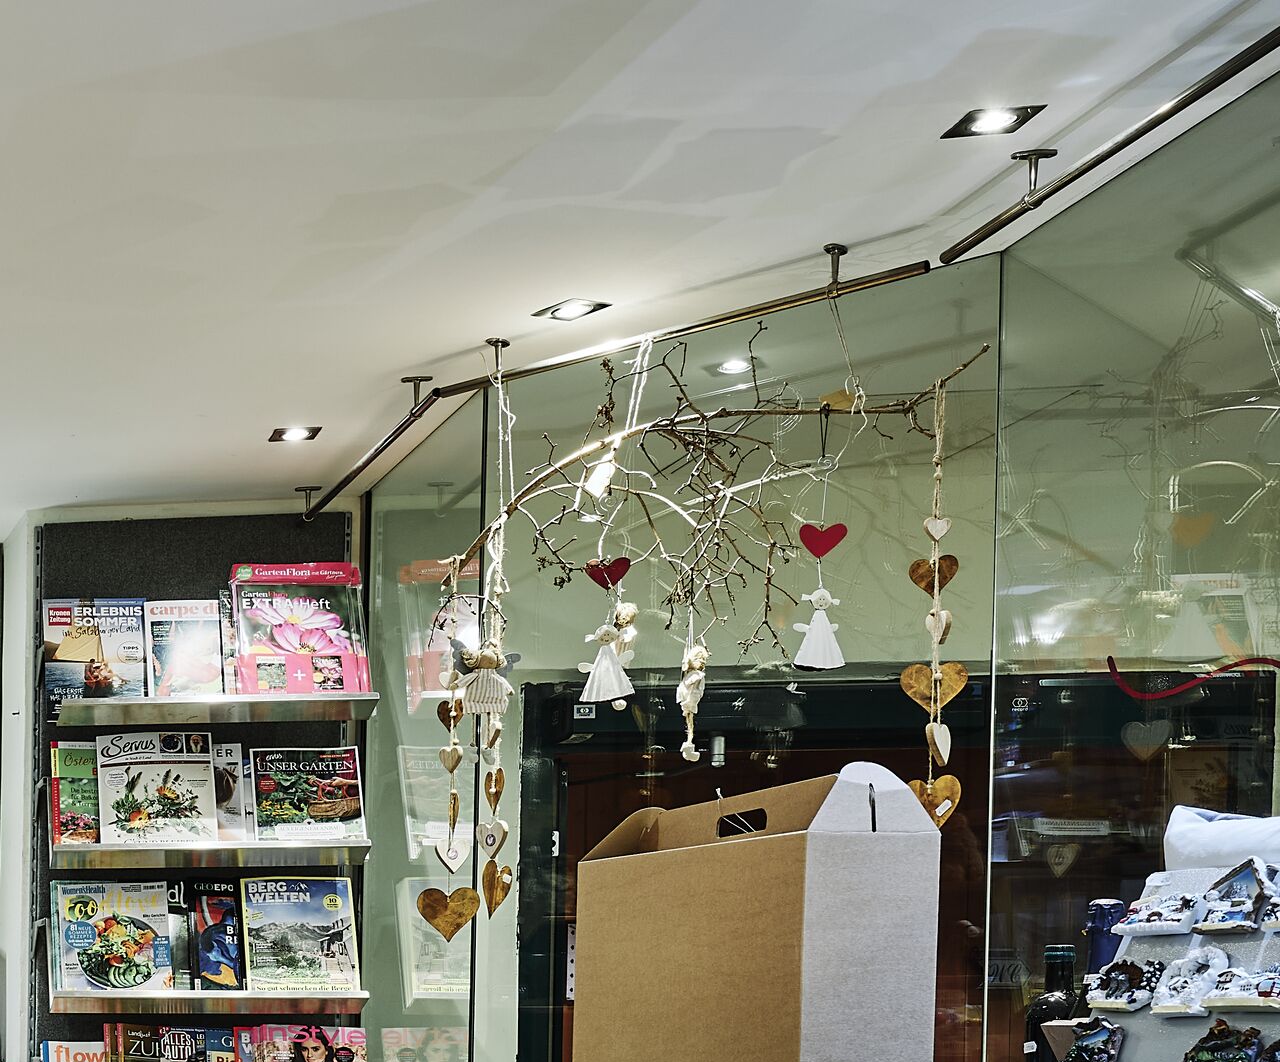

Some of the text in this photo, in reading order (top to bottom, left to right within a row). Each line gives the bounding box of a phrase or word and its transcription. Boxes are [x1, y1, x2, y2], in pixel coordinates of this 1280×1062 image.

[255, 568, 310, 577] GartenFlora
[242, 598, 331, 610] EXTRA-Heft
[74, 606, 143, 617] ERLEBNIS
[150, 605, 198, 618] carpe
[49, 616, 71, 624] Zeitung
[74, 617, 138, 627] SOMMER
[101, 736, 156, 759] Servus
[257, 761, 353, 771] UNSER GARTEN
[248, 882, 287, 893] BERG
[249, 892, 311, 903] WELTEN
[164, 1032, 191, 1046] ALLES
[261, 1025, 366, 1046] InStyle
[165, 1045, 191, 1060] AUTO
